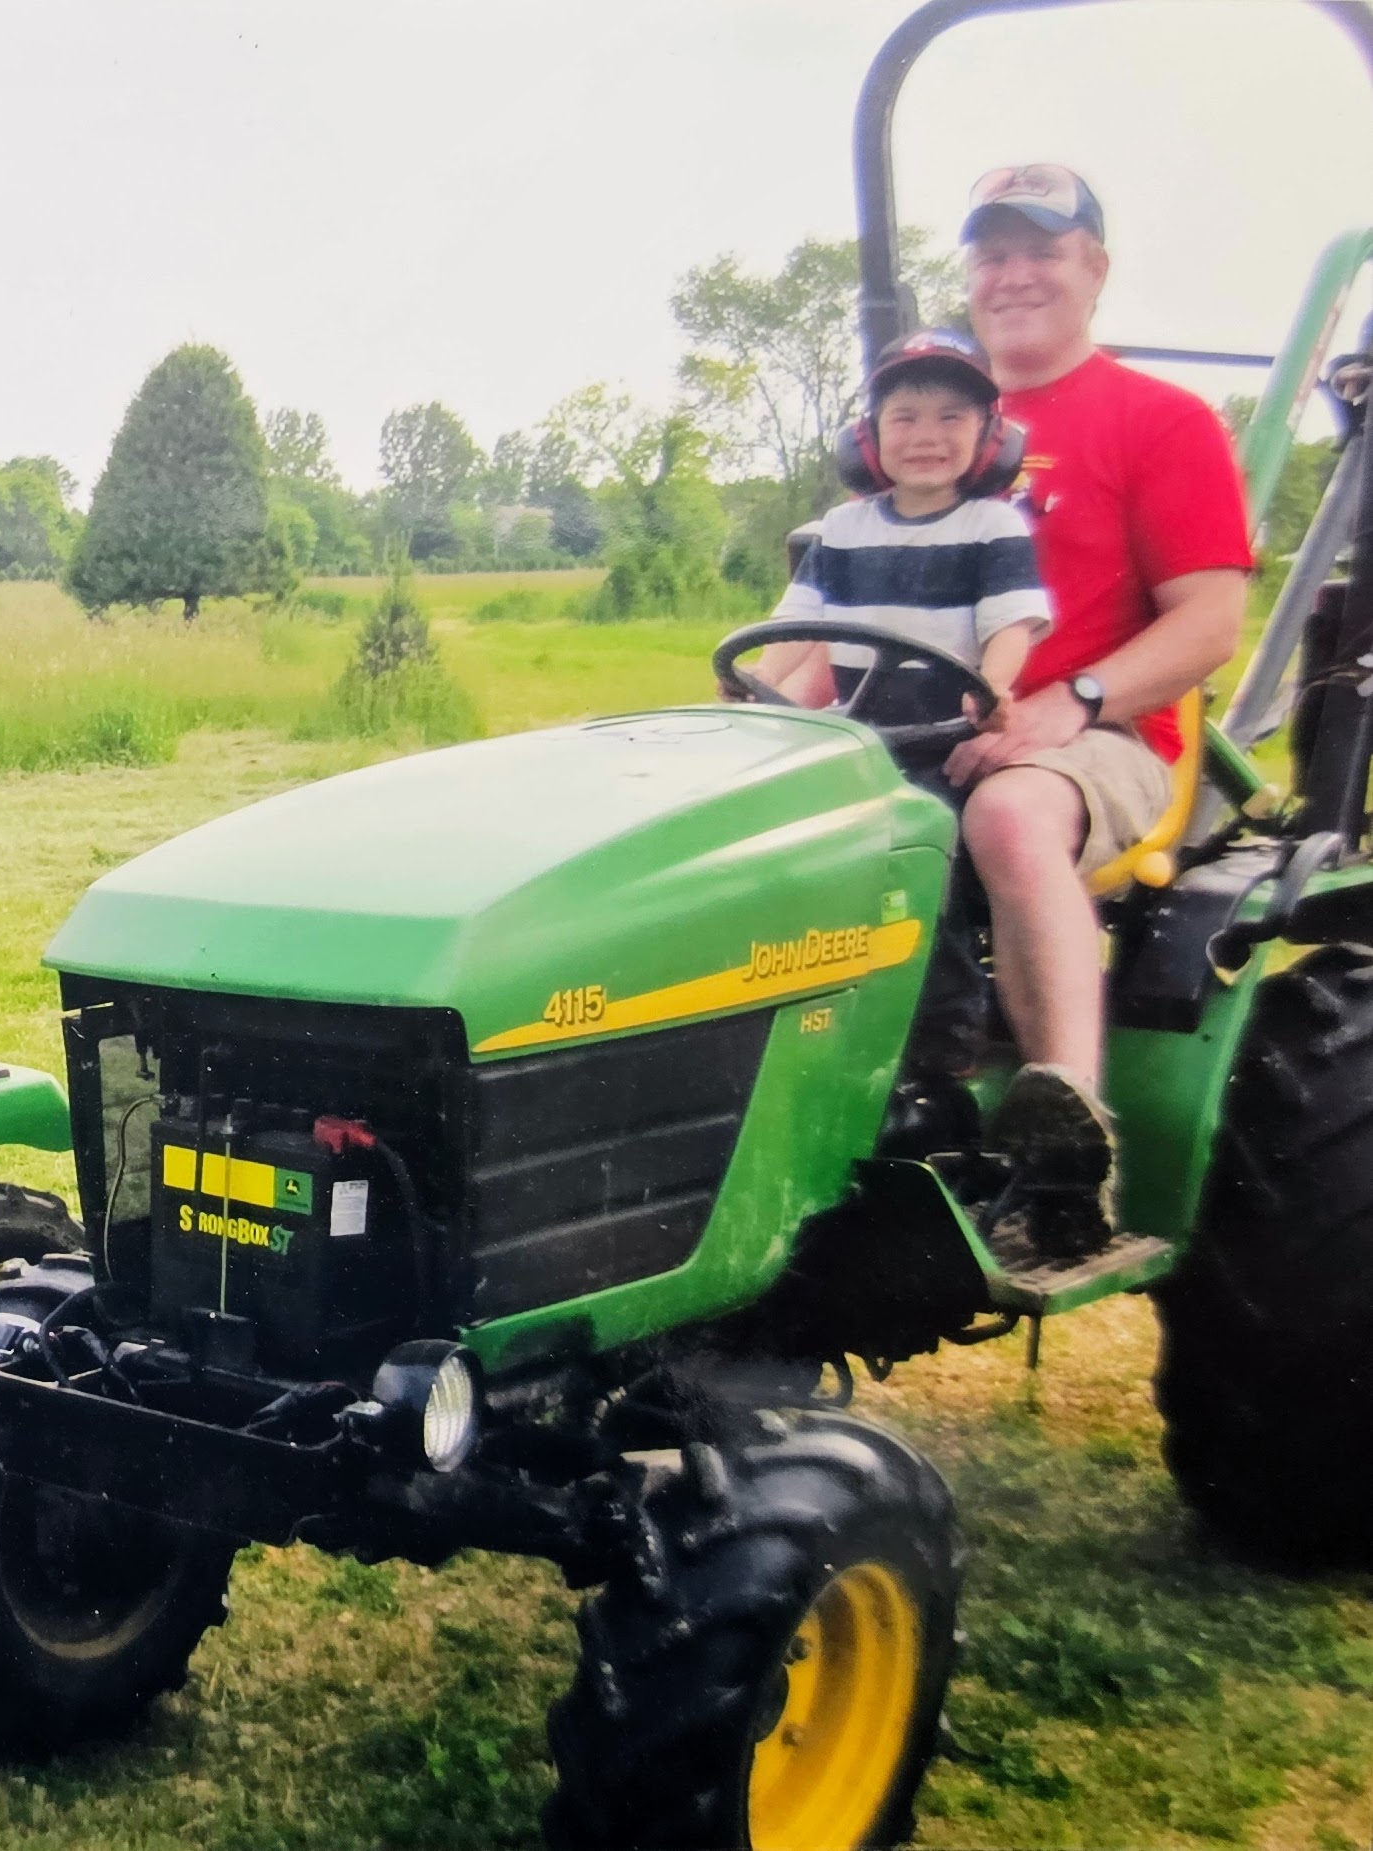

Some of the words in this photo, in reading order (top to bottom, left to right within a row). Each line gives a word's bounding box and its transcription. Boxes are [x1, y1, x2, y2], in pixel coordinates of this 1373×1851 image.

[742, 939, 803, 982] JOHN
[806, 924, 868, 968] DEERE
[543, 985, 605, 1026] 4115
[799, 1007, 833, 1034] HST
[179, 1204, 269, 1246] SRONGBOX
